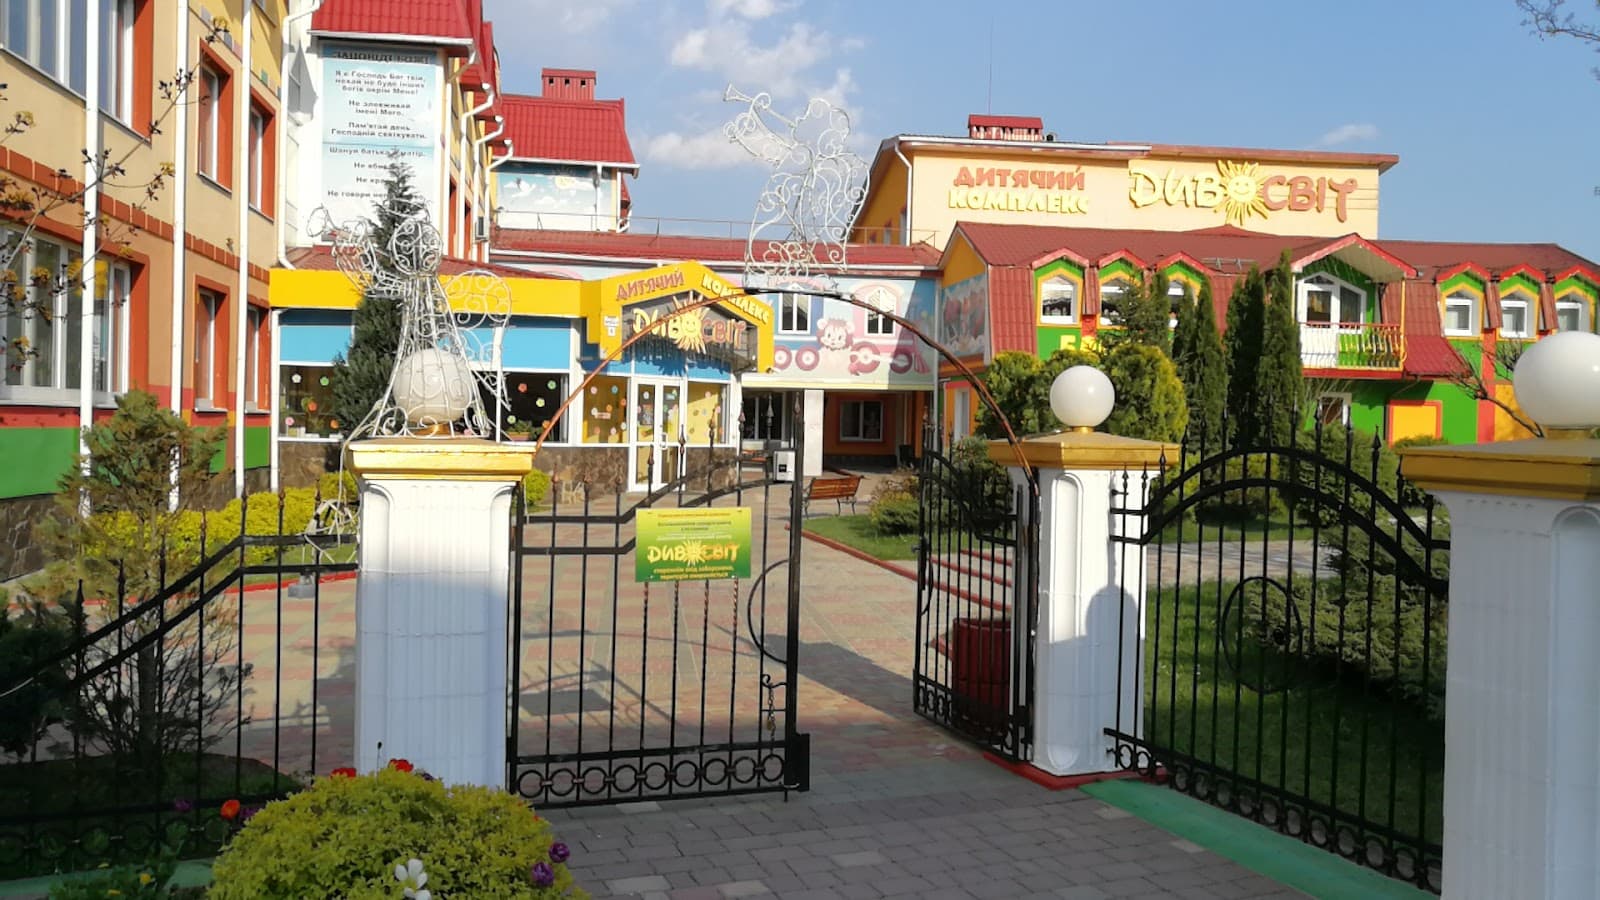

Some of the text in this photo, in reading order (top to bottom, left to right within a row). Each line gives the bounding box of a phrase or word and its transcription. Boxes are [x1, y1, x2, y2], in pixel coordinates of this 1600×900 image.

[351, 71, 386, 79] Господь
[331, 128, 376, 136] Господній
[329, 147, 359, 155] Шануй
[953, 165, 1086, 190] ДИТЯЧИЙ
[948, 188, 1089, 214] КОМПЛЕКС
[616, 269, 684, 301] ДИТЯЧИЙ
